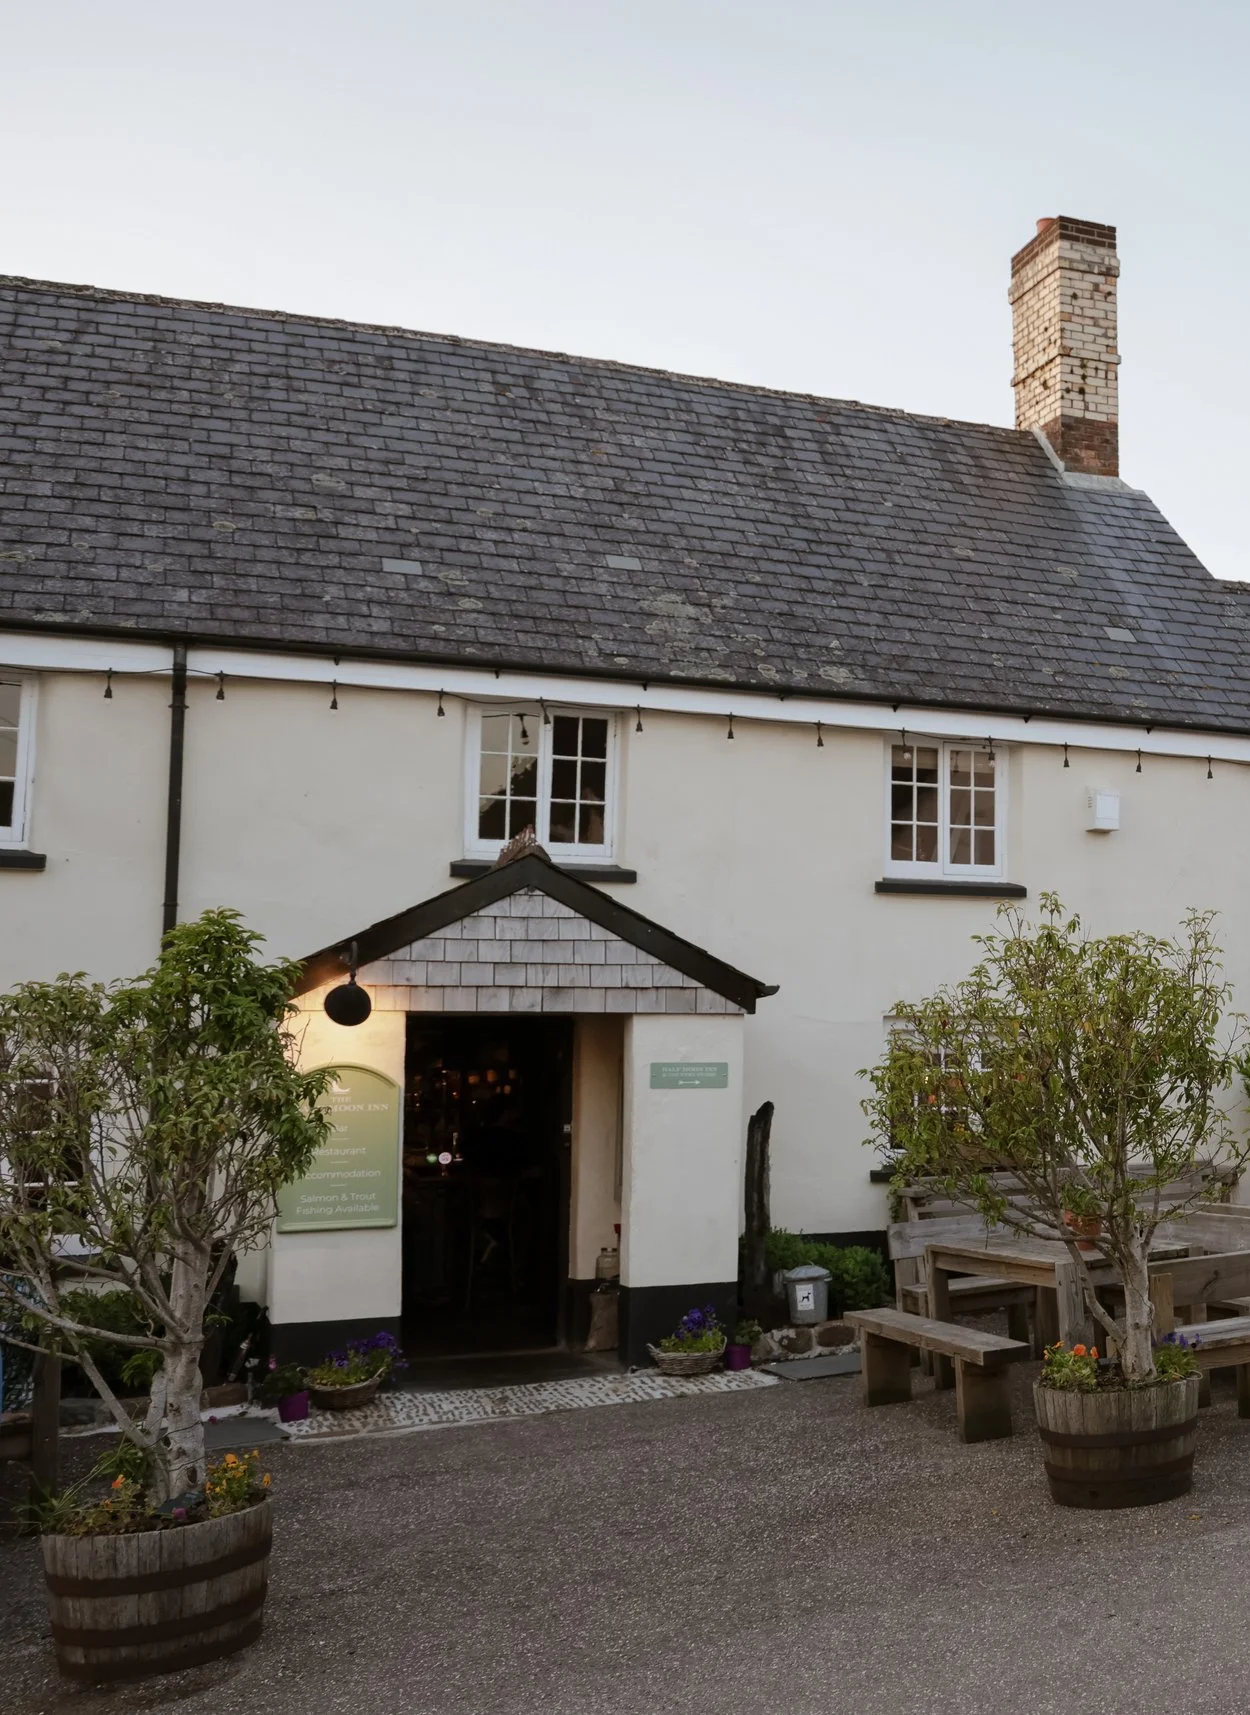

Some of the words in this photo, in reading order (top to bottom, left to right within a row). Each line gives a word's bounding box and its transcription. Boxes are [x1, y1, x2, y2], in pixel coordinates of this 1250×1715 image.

[366, 1103, 389, 1111] INN
[304, 1169, 381, 1180] ccommodation
[300, 1194, 338, 1203] Salmon
[350, 1192, 376, 1201] Trout
[296, 1206, 333, 1216] Fishing
[335, 1203, 380, 1213] Available
